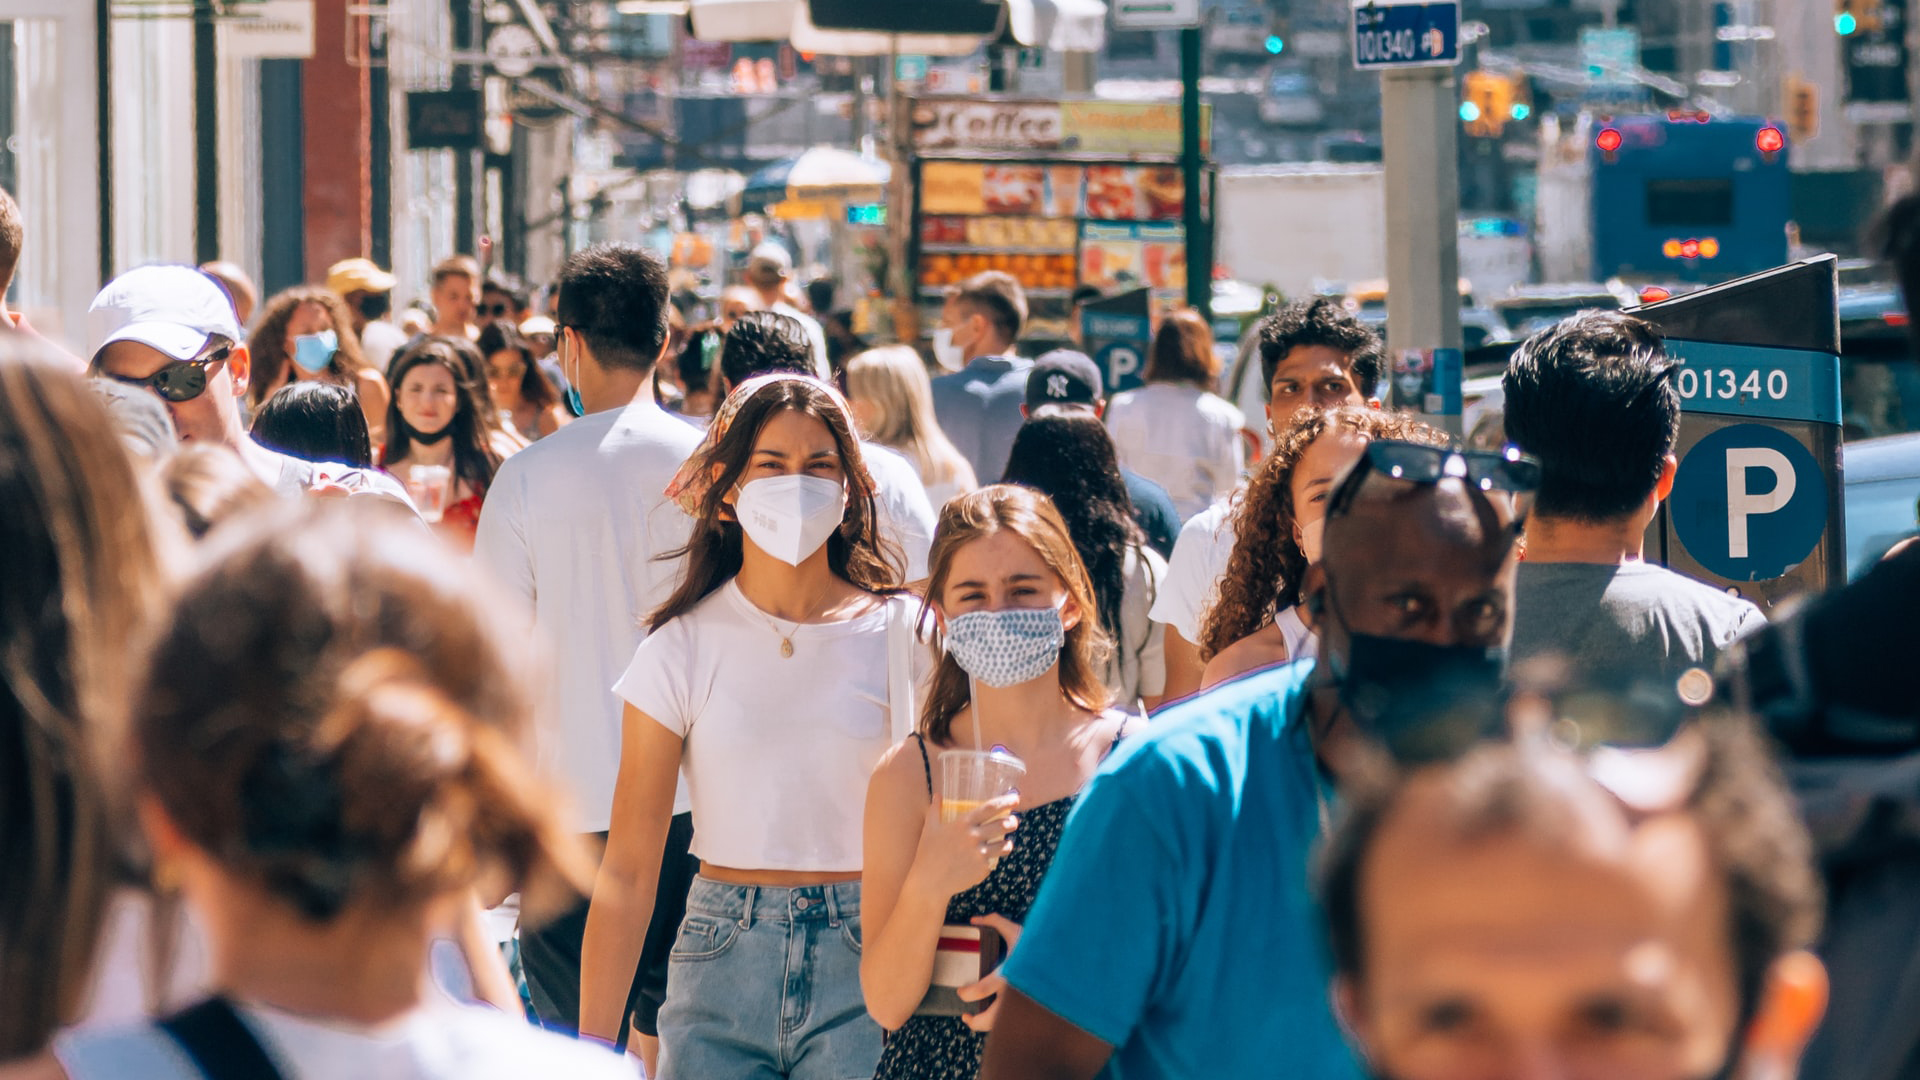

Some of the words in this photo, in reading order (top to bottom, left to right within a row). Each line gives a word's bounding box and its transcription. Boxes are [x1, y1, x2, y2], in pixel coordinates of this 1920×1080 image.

[1359, 29, 1415, 60] 101340
[946, 107, 1056, 136] Coffee
[1109, 347, 1138, 390] P
[1046, 374, 1069, 398] NY
[1726, 447, 1797, 558] P
